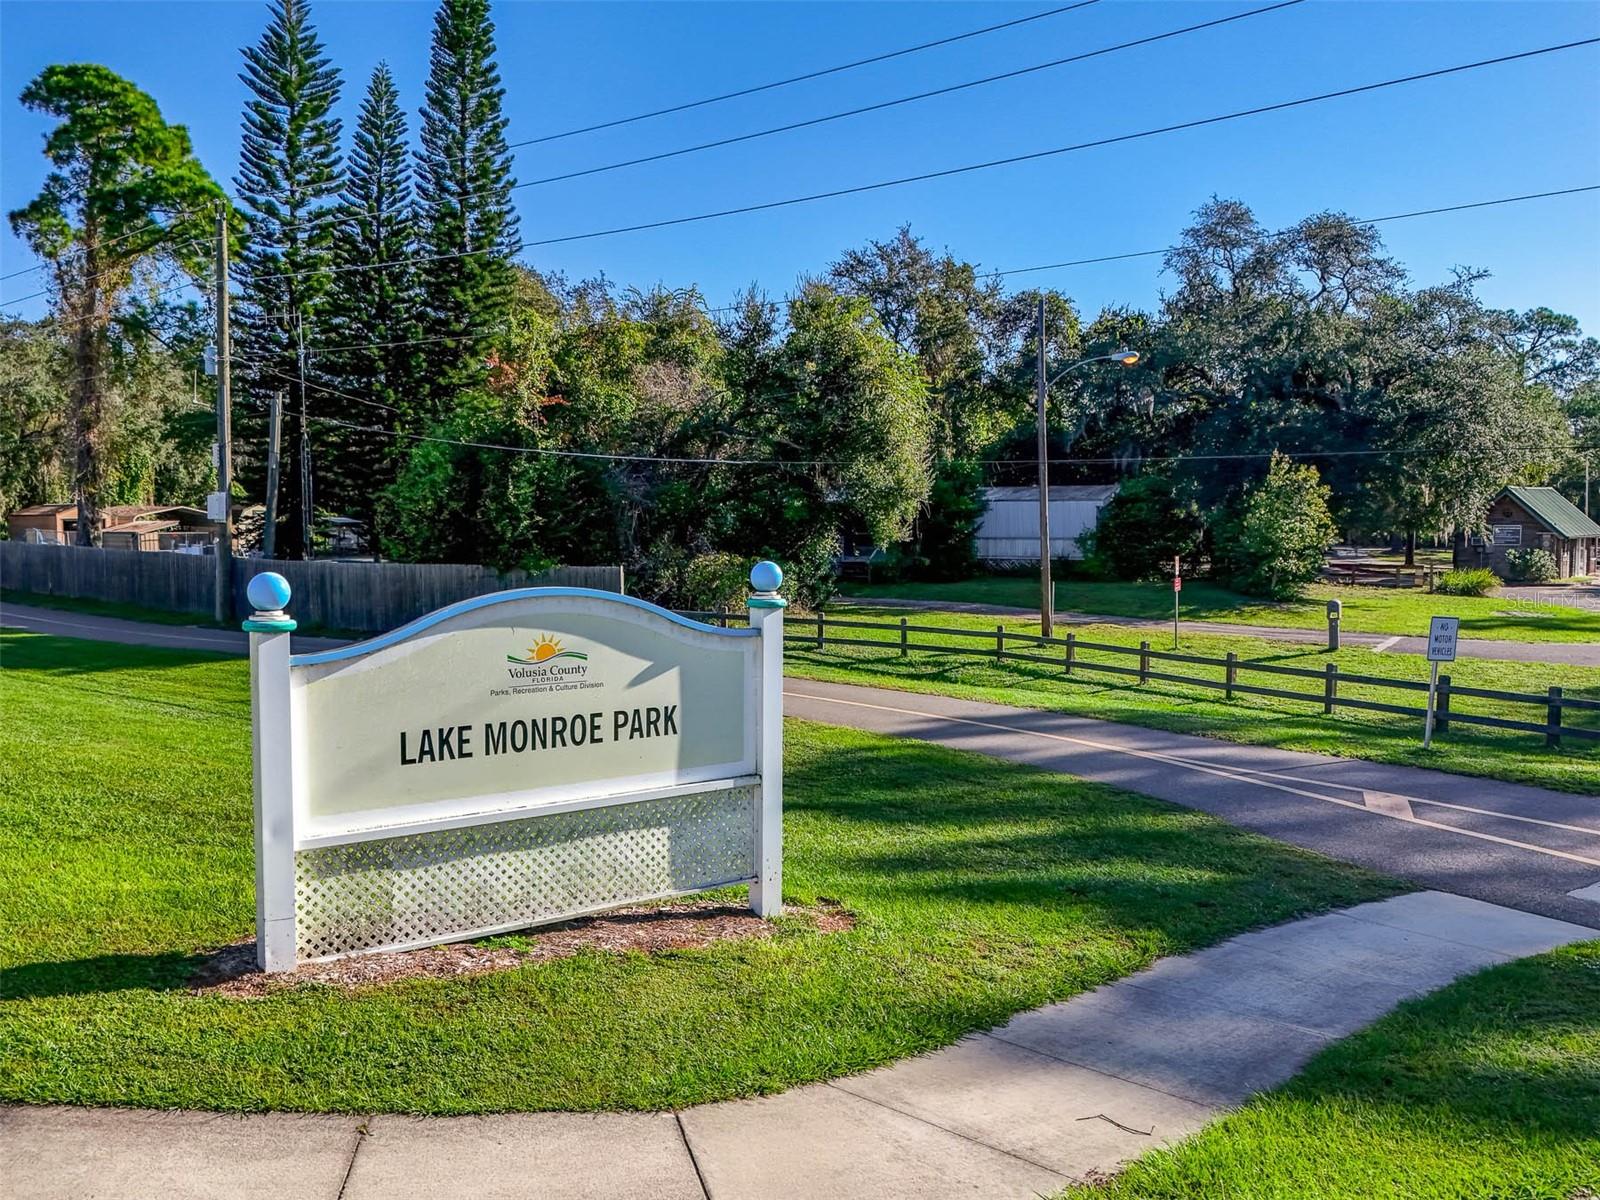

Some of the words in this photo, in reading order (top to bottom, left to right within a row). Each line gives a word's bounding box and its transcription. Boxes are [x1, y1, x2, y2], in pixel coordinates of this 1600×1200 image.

[1434, 634, 1453, 643] MOTOR
[508, 666, 547, 679] Volusia
[549, 664, 588, 677] County
[512, 686, 548, 695] Recreation
[555, 684, 578, 692] Culture
[580, 681, 604, 689] Division
[400, 725, 473, 765] LAKE
[484, 712, 603, 756] MONROE
[613, 705, 678, 741] PARK
